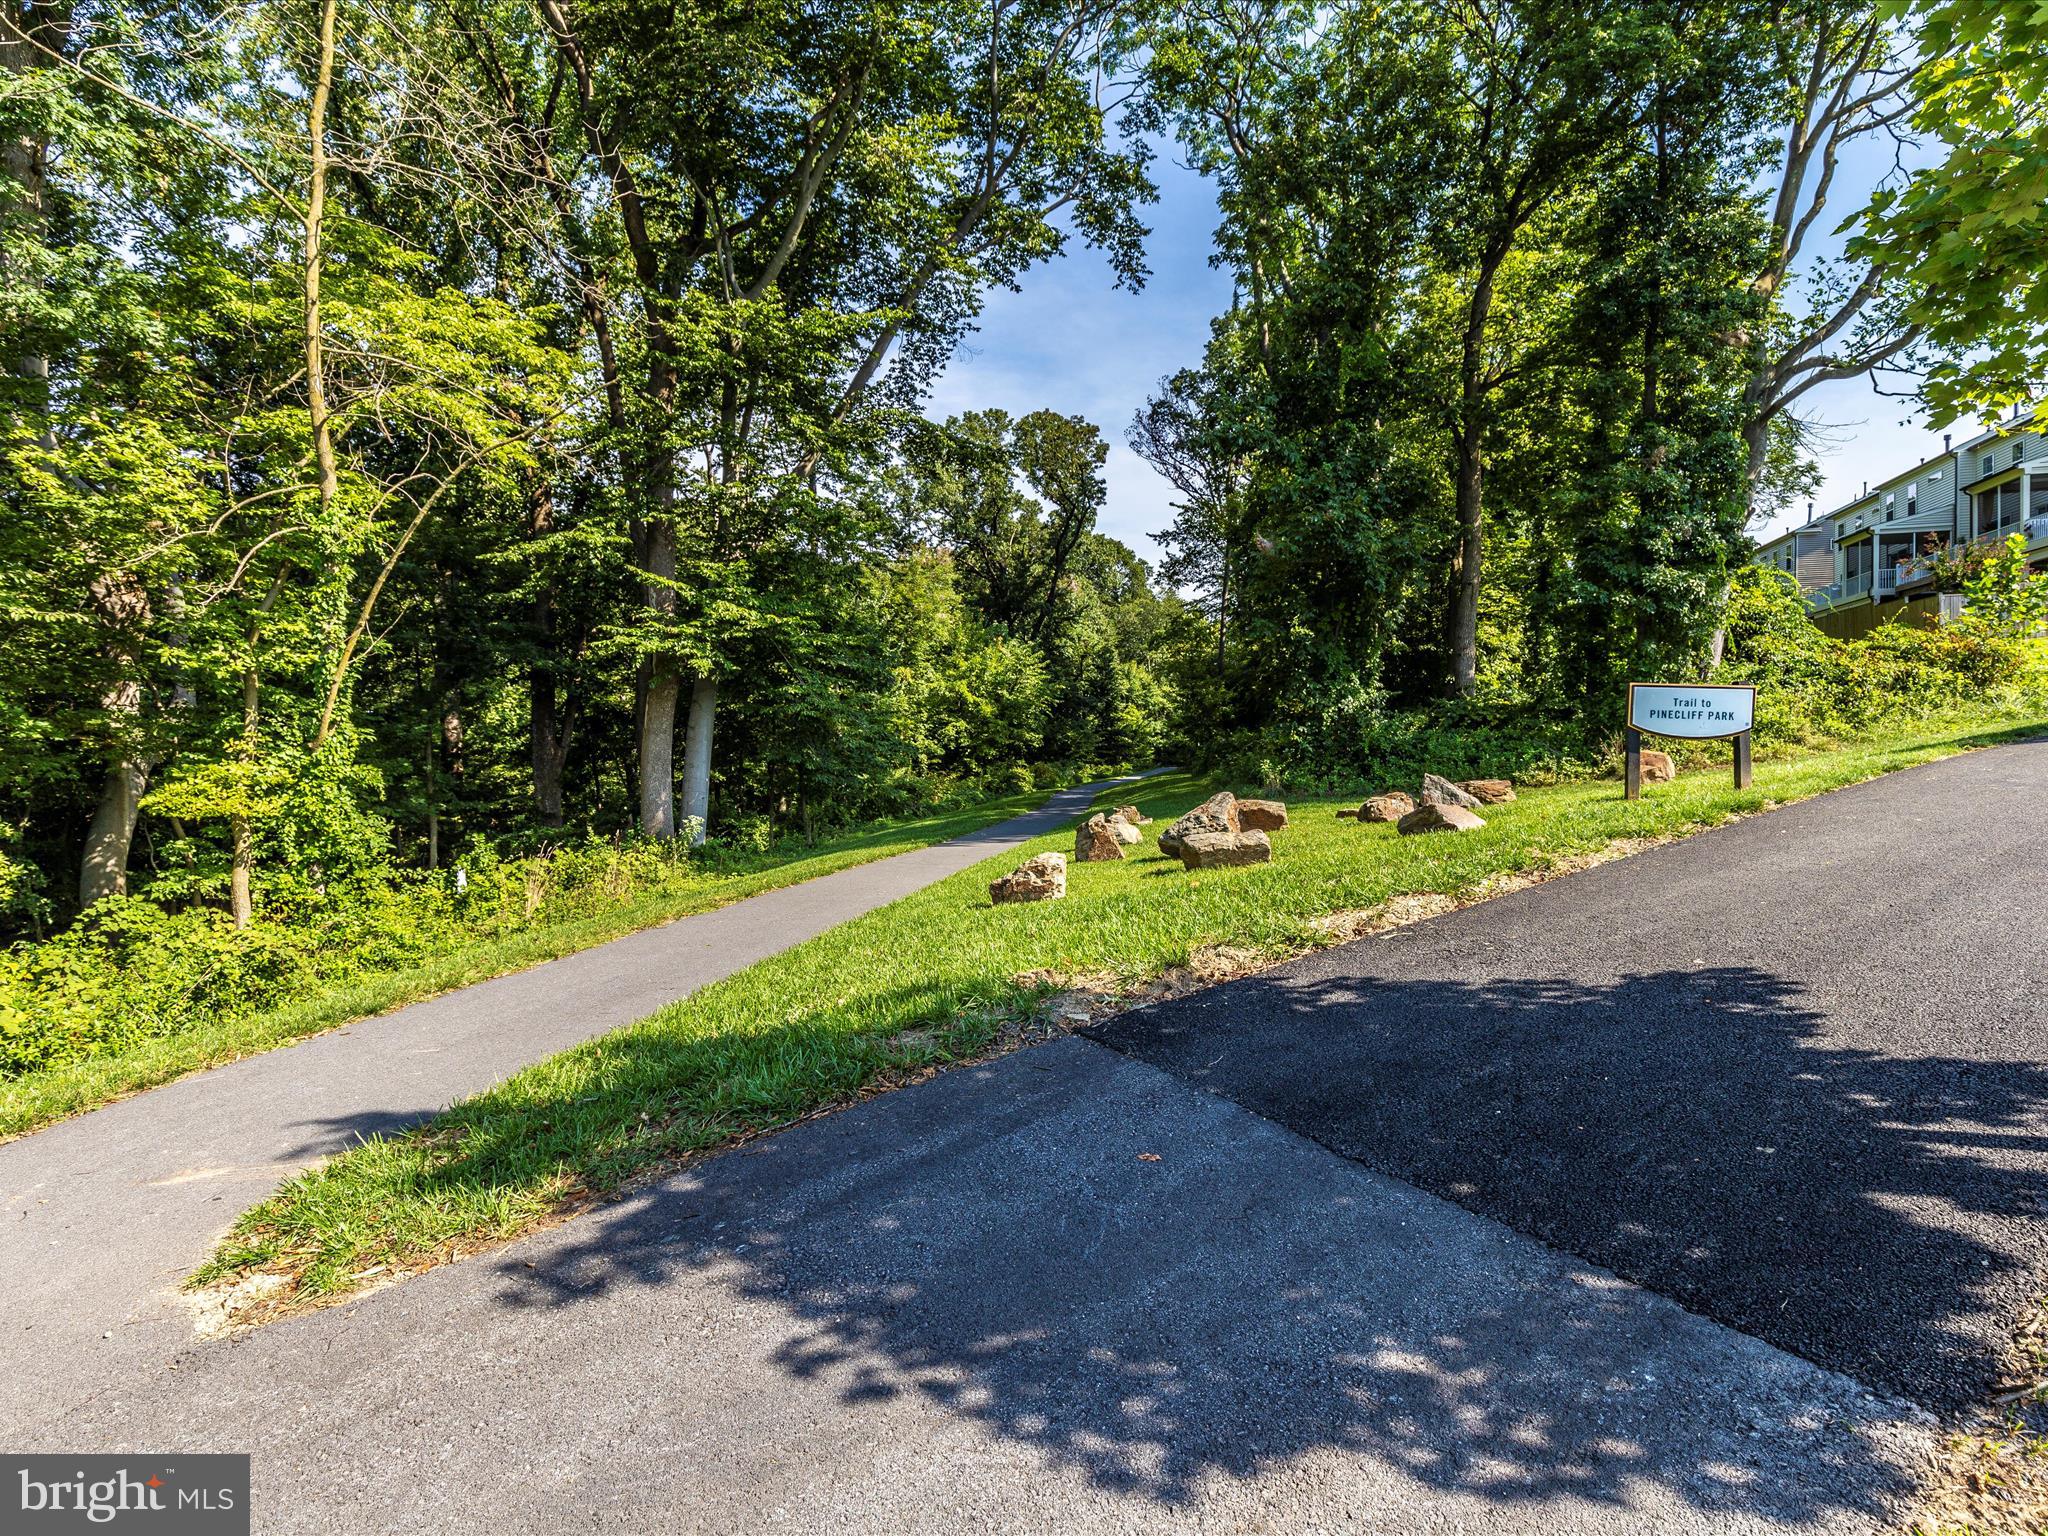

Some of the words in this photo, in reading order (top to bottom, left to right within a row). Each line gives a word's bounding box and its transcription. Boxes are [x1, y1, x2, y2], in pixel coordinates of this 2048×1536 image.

[1673, 697, 1697, 708] Trail
[1701, 698, 1711, 708] to
[1649, 709, 1703, 720] PINECLIFF
[1707, 711, 1735, 721] PARK
